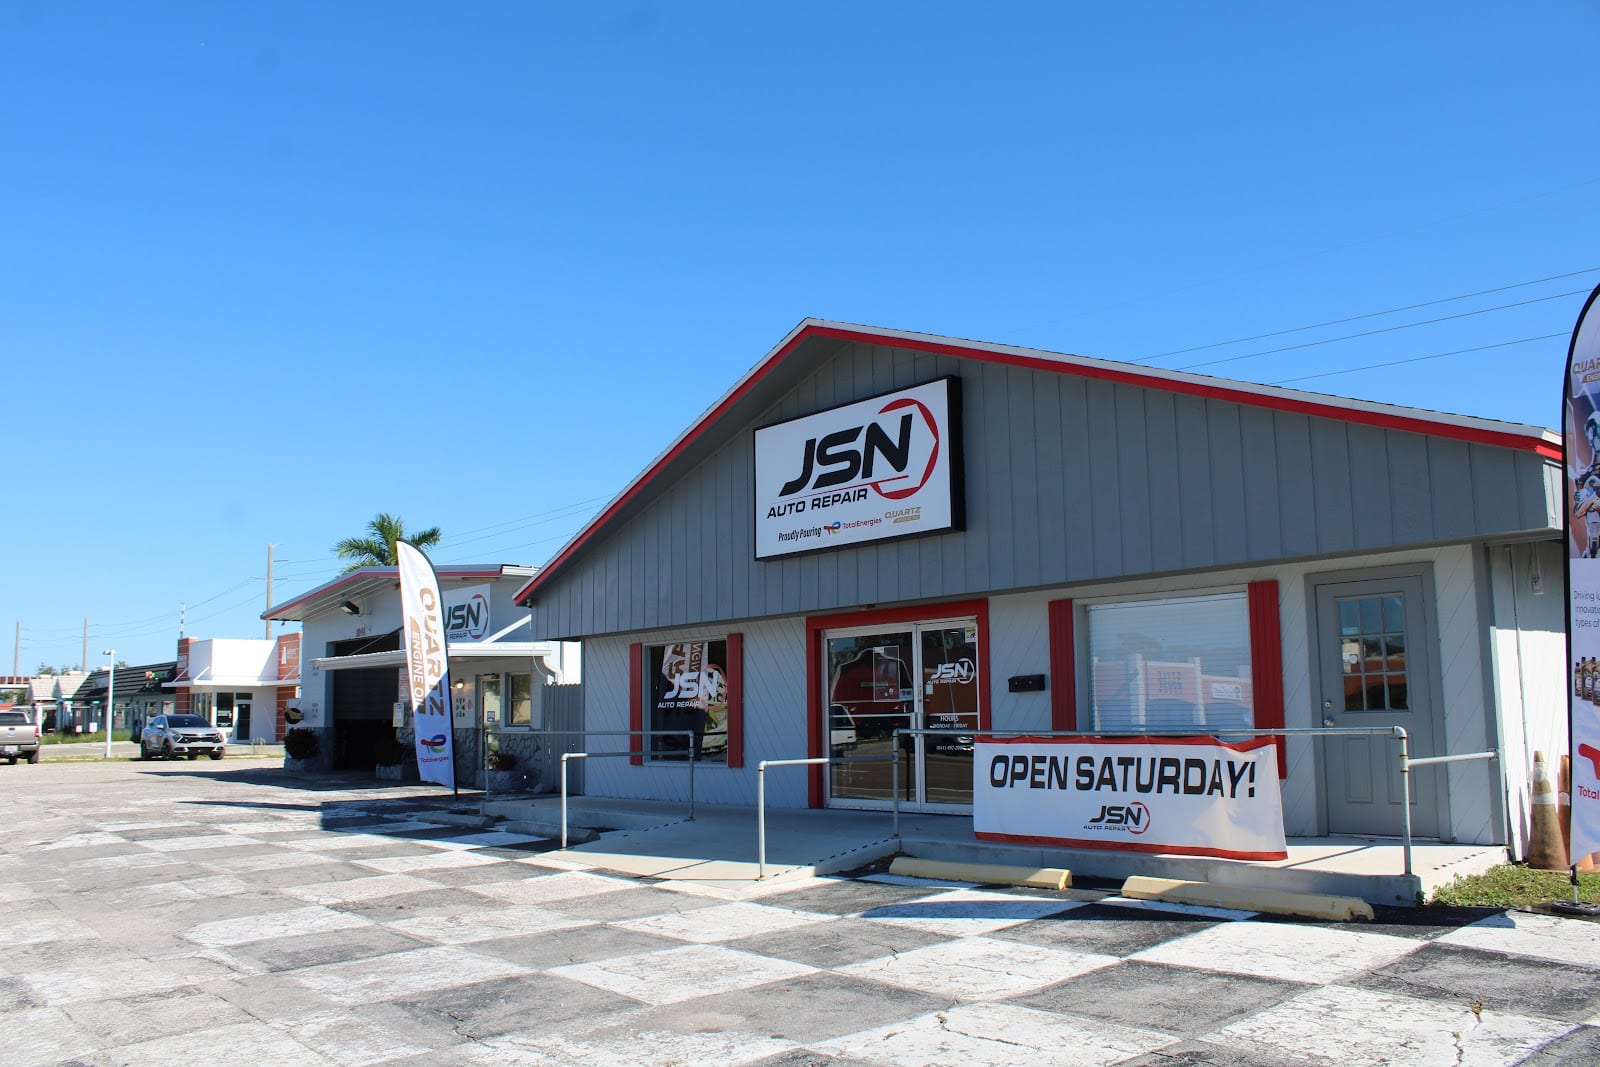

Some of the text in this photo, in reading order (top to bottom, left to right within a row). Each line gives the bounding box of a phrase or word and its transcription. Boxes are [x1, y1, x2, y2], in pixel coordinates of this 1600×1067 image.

[778, 413, 913, 497] JSN
[767, 488, 868, 519] AUTO REPAIR
[884, 506, 921, 519] QUARTZ
[842, 517, 882, 529] TotalEnergies
[778, 526, 821, 542] Proudly Pouring
[1576, 618, 1591, 629] types
[411, 631, 424, 685] ENGINE
[419, 587, 445, 716] QUARTZ
[930, 662, 968, 679] JSN
[664, 670, 719, 699] JSN
[657, 701, 675, 709] AUTO
[990, 754, 1256, 798] OPEN SATURDAY!
[1089, 805, 1142, 826] JSN
